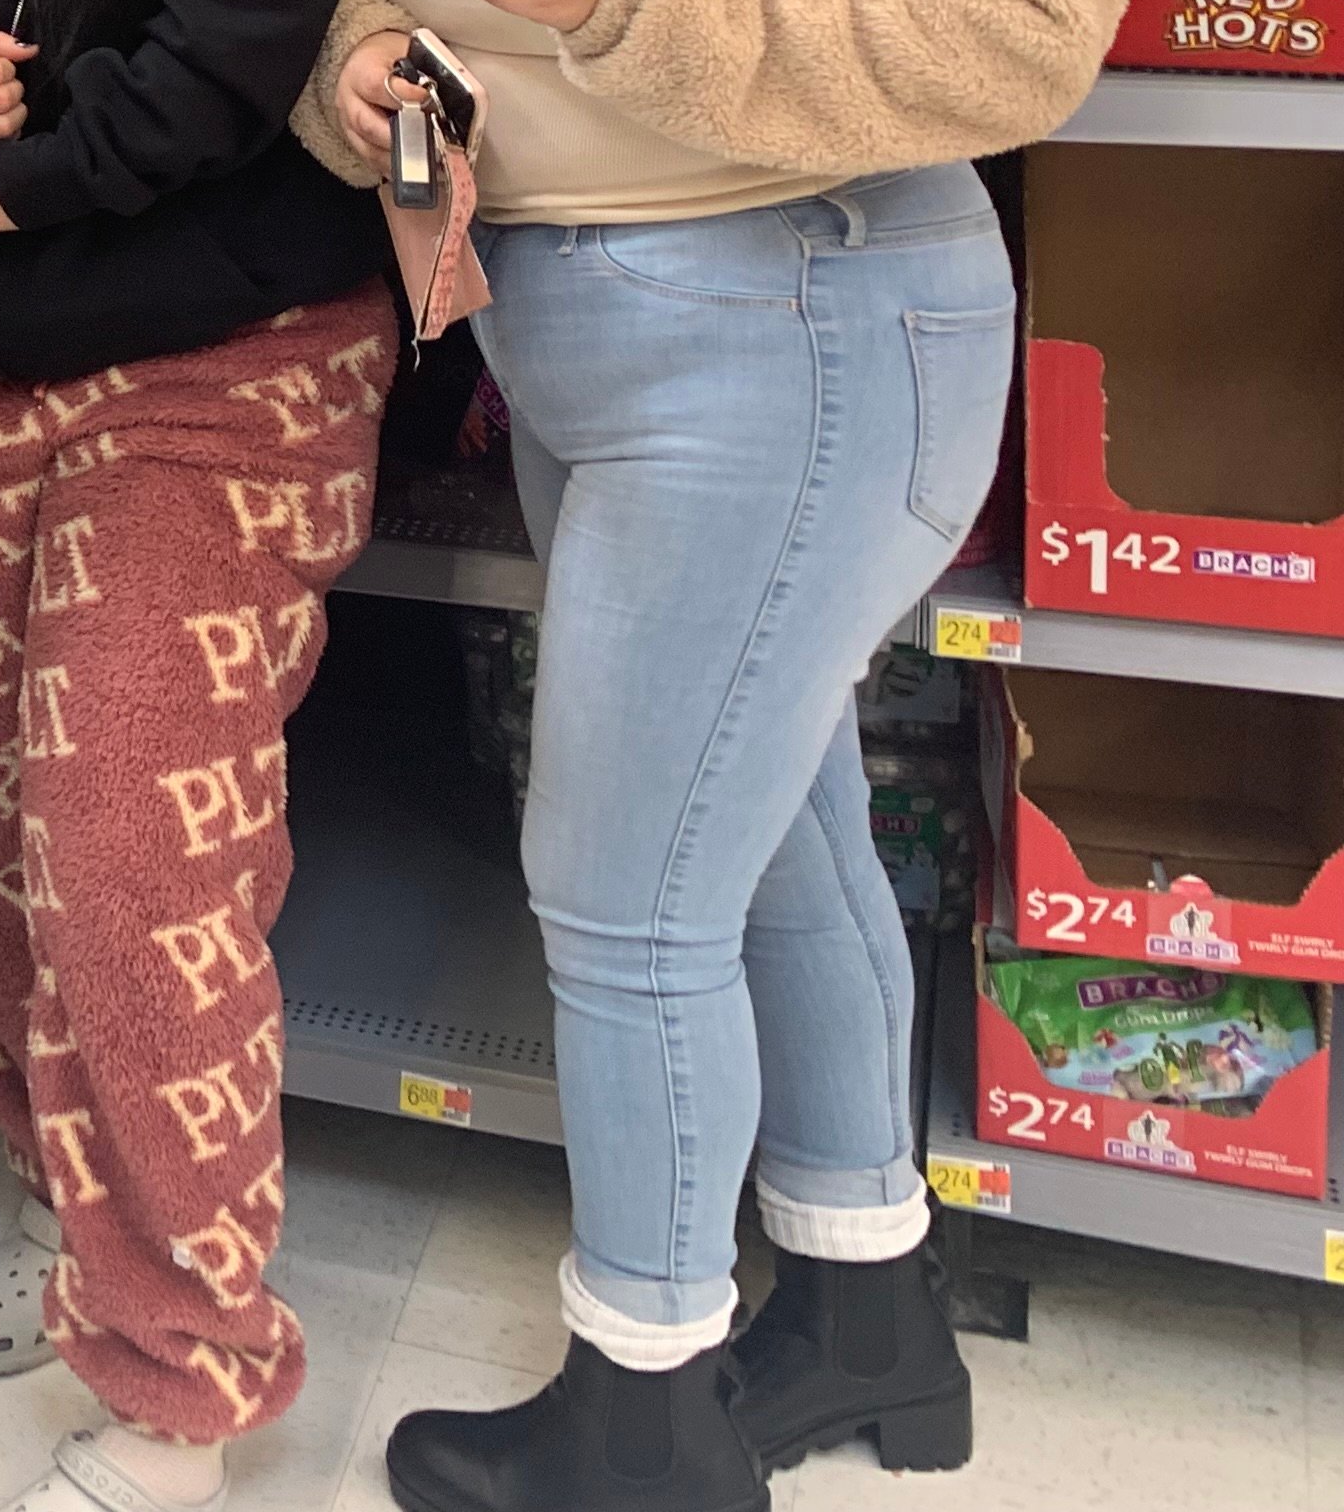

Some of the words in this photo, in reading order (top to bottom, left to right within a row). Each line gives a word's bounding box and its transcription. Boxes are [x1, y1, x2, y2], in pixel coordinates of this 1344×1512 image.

[1173, 12, 1321, 54] HOTS
[1041, 521, 1181, 594] $142
[1026, 887, 1136, 943] $274
[1248, 940, 1289, 954] TWIRLY
[1291, 943, 1319, 956] GUM
[987, 1088, 1095, 1142] $274
[1204, 1150, 1245, 1165] TWIRLY
[1246, 1155, 1275, 1170] GUM
